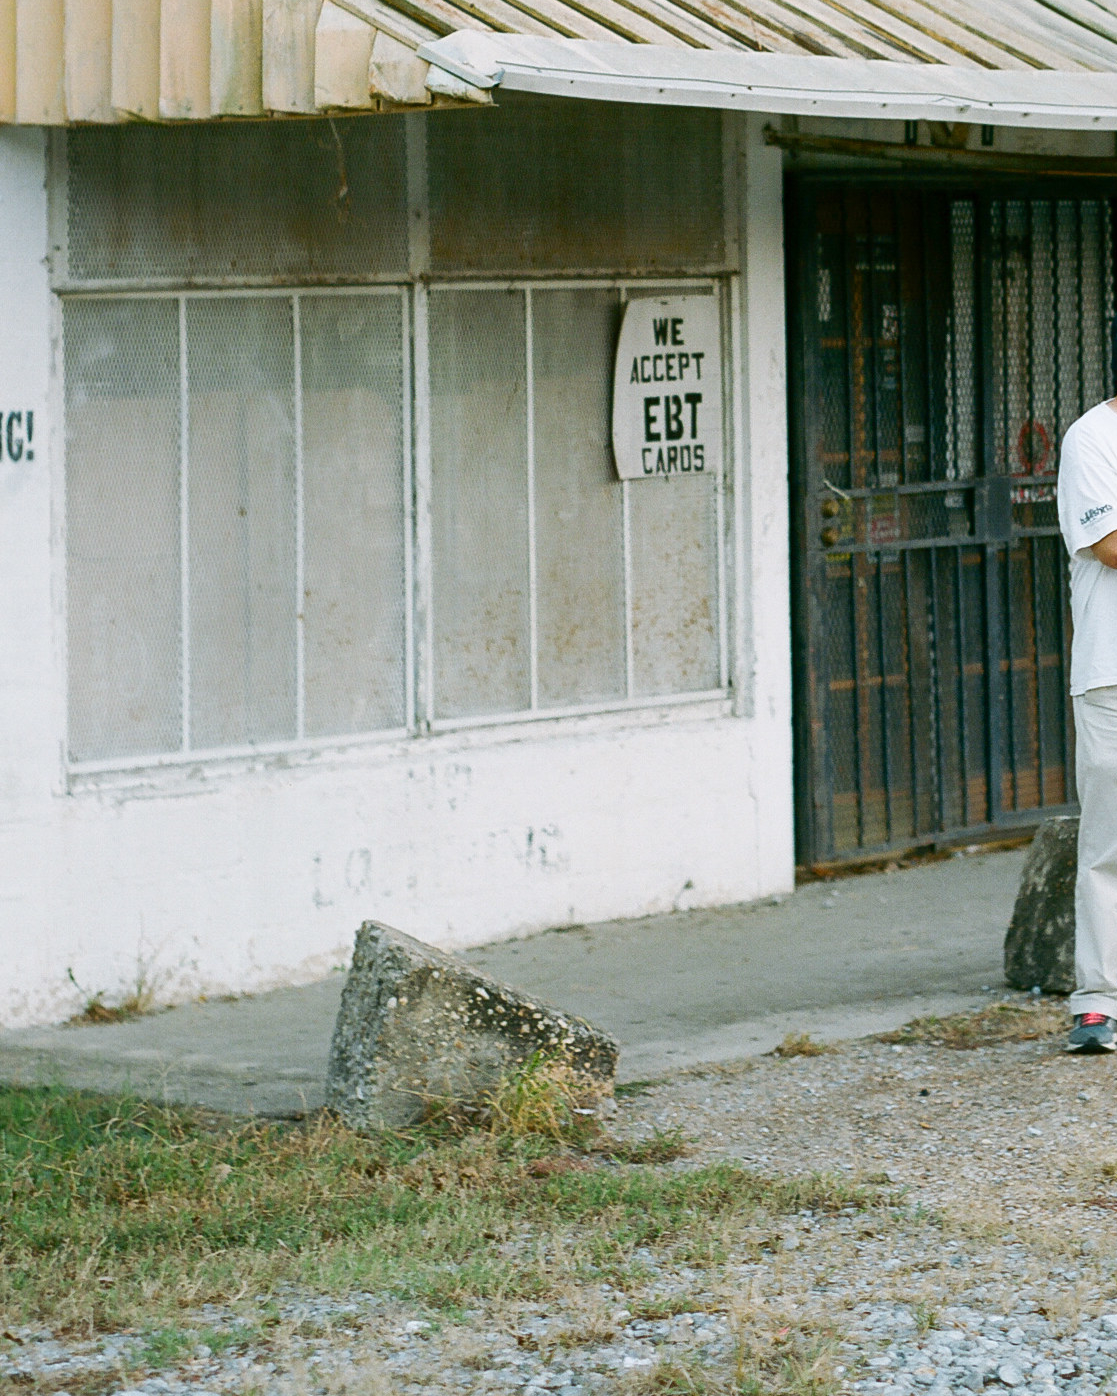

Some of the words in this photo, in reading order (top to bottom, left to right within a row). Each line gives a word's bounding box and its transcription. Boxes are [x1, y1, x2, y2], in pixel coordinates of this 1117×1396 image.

[653, 317, 684, 346] WE
[630, 352, 705, 384] ACCEPT
[643, 393, 702, 442] EBT
[0, 410, 34, 463] G!
[641, 445, 704, 475] CARDS
